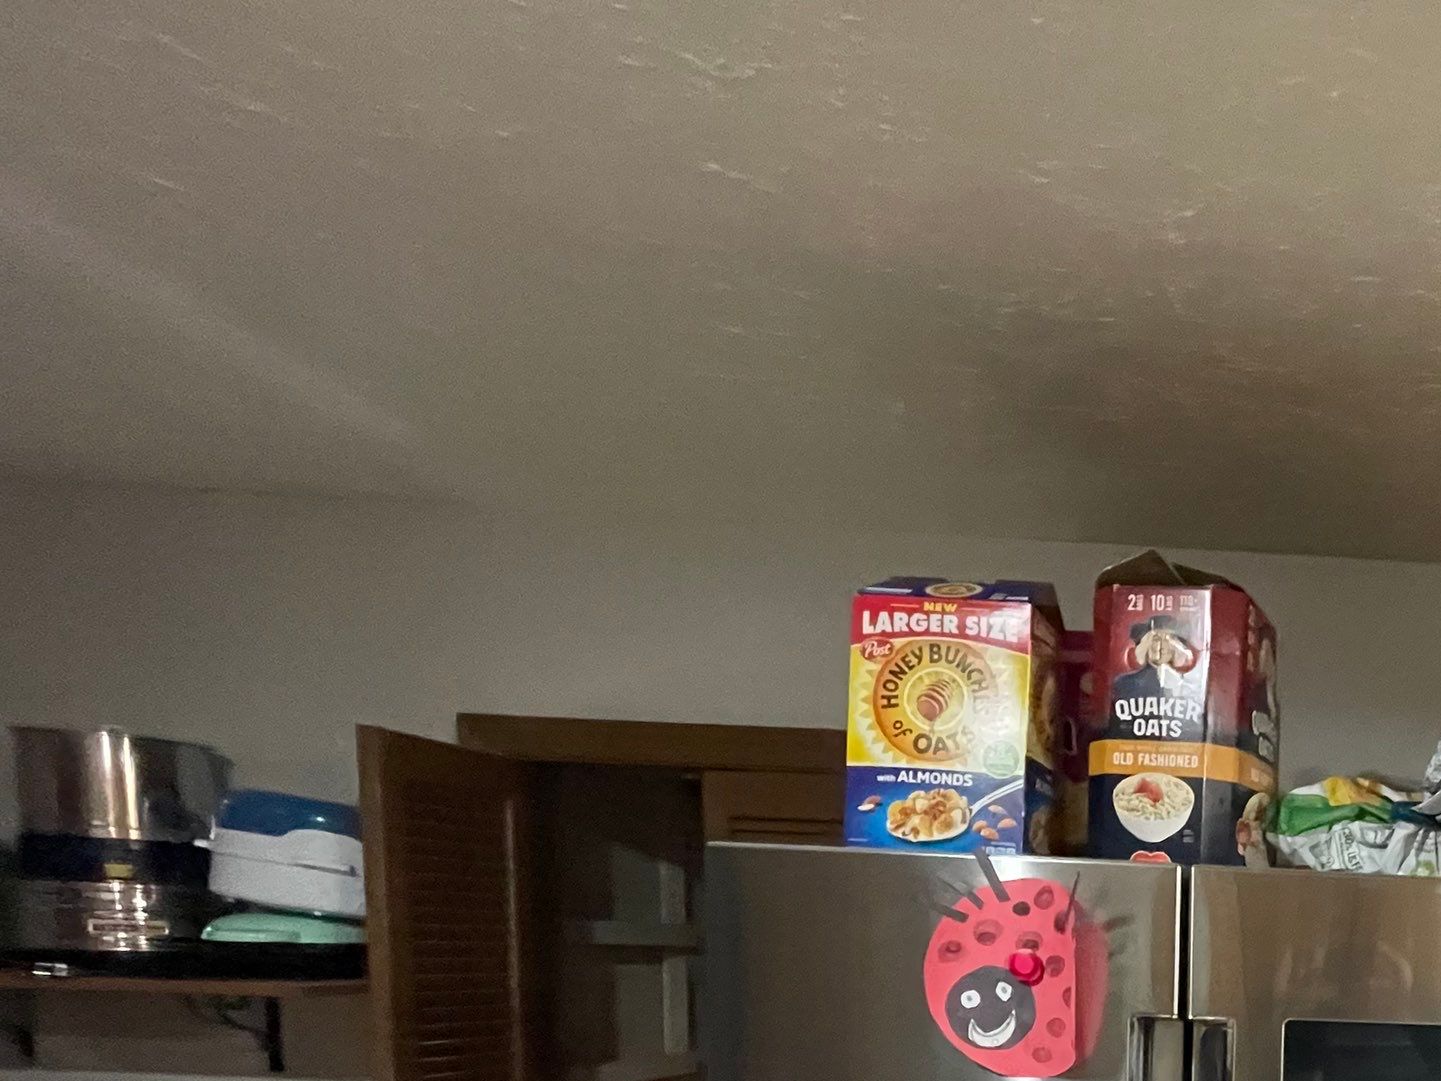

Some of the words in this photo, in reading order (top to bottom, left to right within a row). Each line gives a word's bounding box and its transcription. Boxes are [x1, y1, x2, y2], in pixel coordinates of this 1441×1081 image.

[923, 602, 958, 612] NEW
[862, 611, 960, 634] LARGER
[965, 615, 1019, 643] SIZE
[864, 639, 891, 657] Post
[881, 646, 924, 710] HONEY
[1115, 697, 1200, 722] QUAKER
[892, 720, 913, 738] of
[912, 727, 976, 755] OATS
[1133, 718, 1182, 738] OATS
[1112, 752, 1134, 766] OLD
[1137, 752, 1200, 769] FASHIONED
[877, 775, 896, 783] with
[897, 770, 973, 787] ALMONDS
